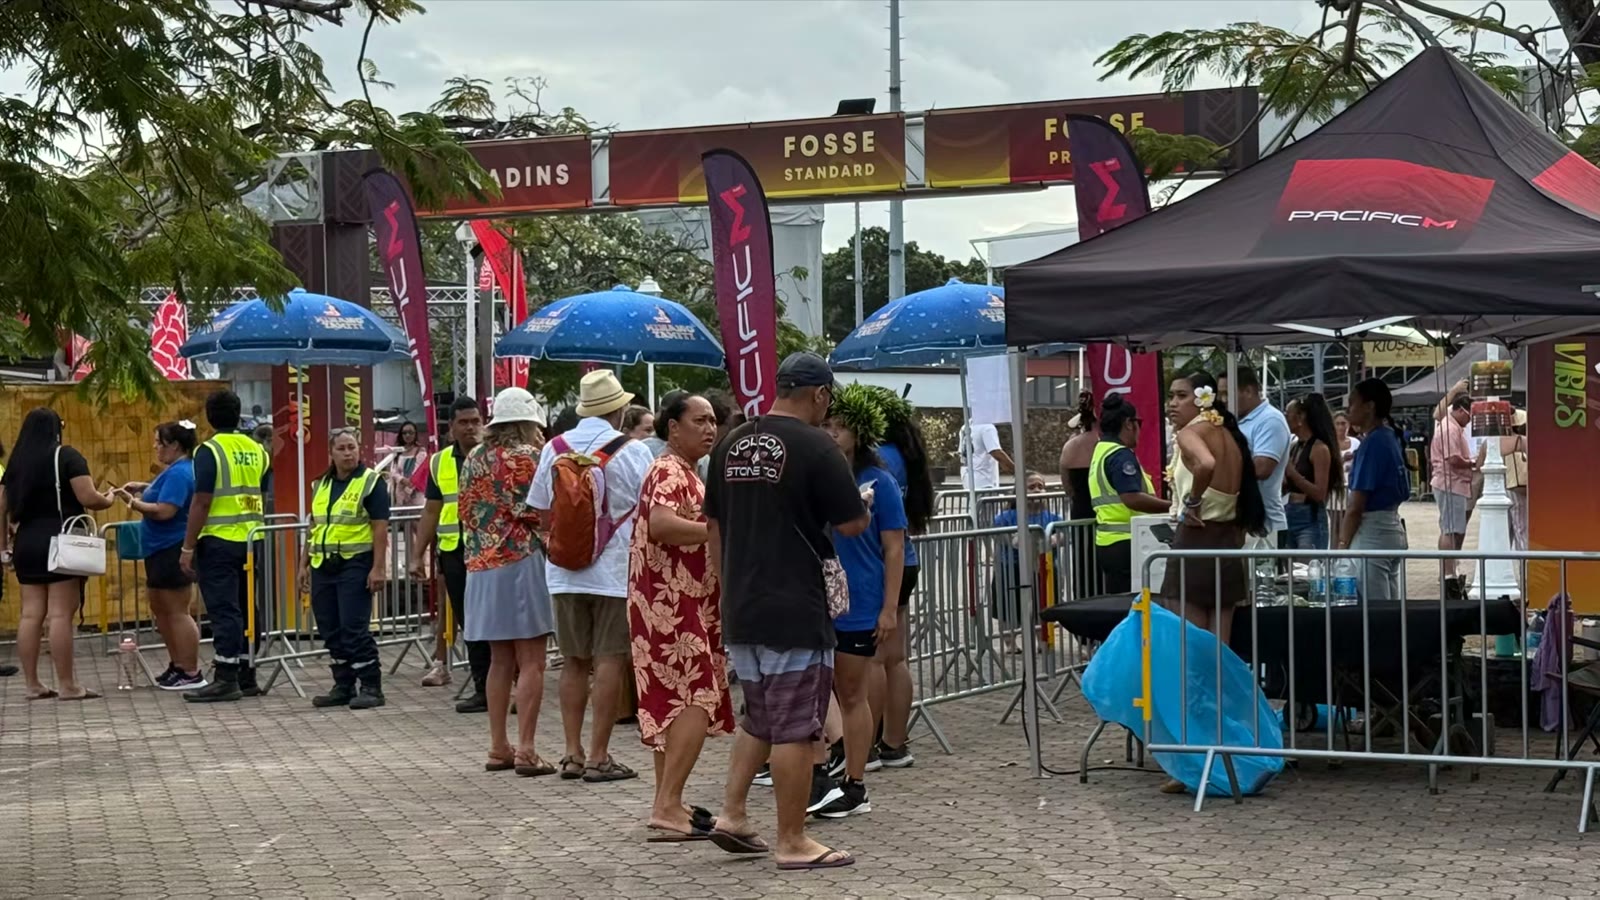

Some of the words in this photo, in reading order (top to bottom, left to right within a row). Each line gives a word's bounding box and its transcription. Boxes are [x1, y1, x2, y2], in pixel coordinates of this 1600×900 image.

[1044, 112, 1144, 141] FSE
[784, 130, 875, 158] FOSSE
[784, 163, 875, 181] STANDARD
[1554, 343, 1587, 428] VIBES
[343, 377, 362, 444] VIBE
[730, 436, 783, 460] VOLCOM
[726, 466, 761, 478] STONE
